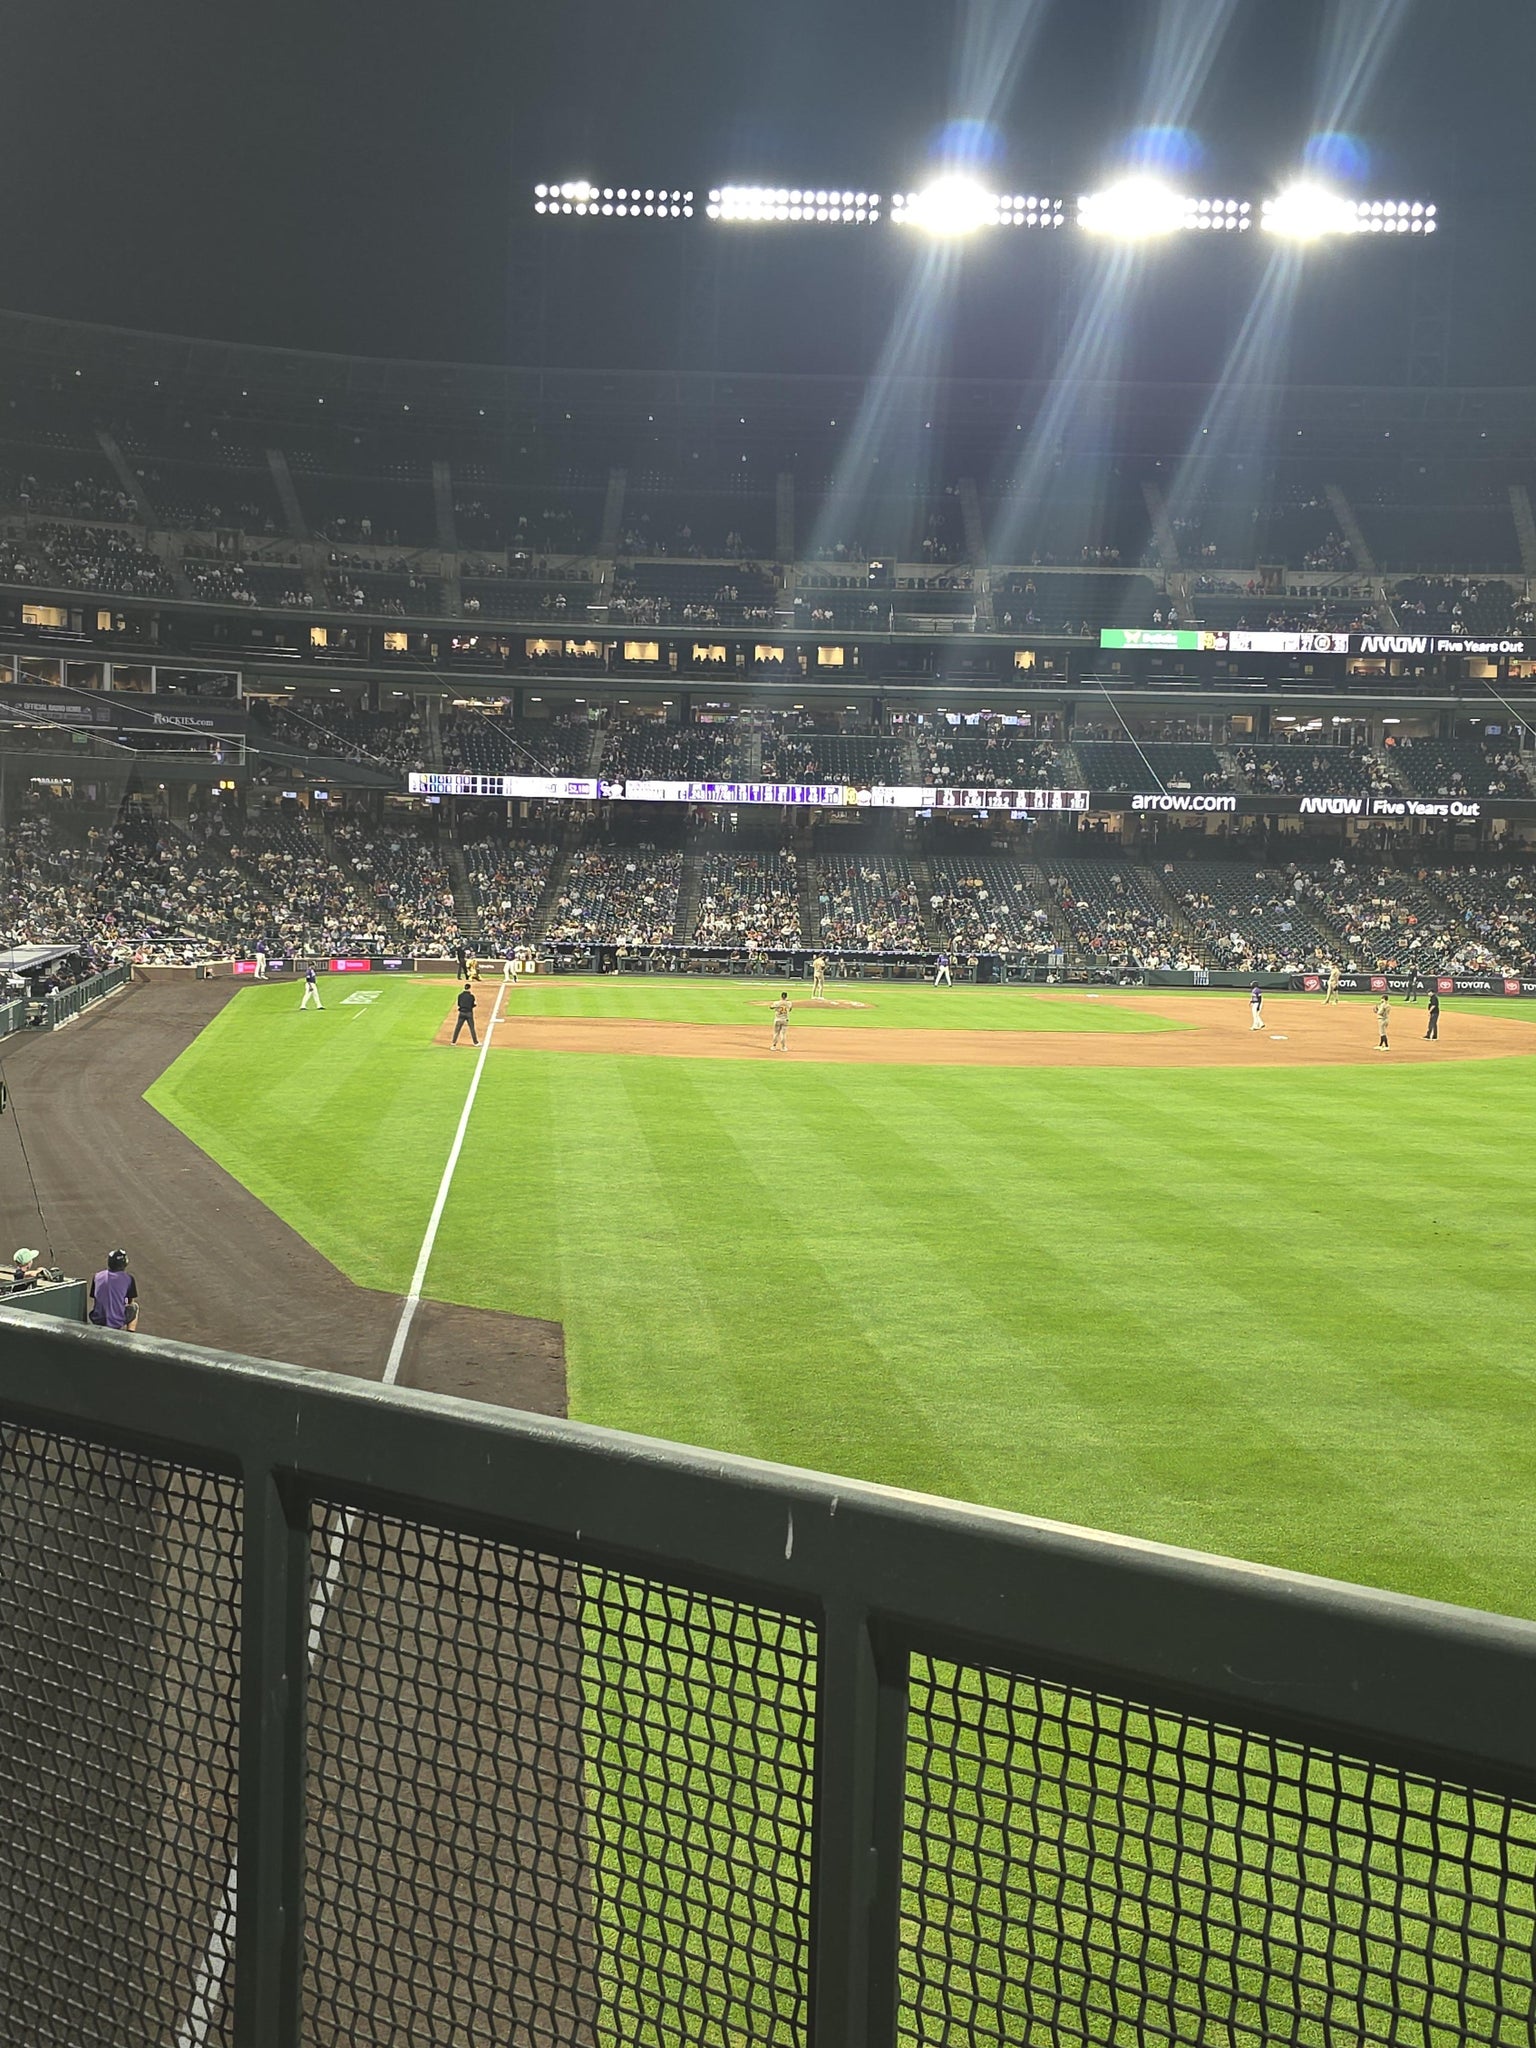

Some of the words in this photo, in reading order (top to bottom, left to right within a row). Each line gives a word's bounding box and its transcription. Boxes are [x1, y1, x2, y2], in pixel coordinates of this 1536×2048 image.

[1438, 640, 1463, 652] Five
[1464, 640, 1498, 653] Years
[1499, 640, 1524, 653] Out
[1132, 794, 1236, 811] arrow.com
[1373, 800, 1404, 814] Five
[1406, 800, 1448, 815] Years
[1450, 801, 1480, 816] Out
[1455, 981, 1490, 989] TOYOTA
